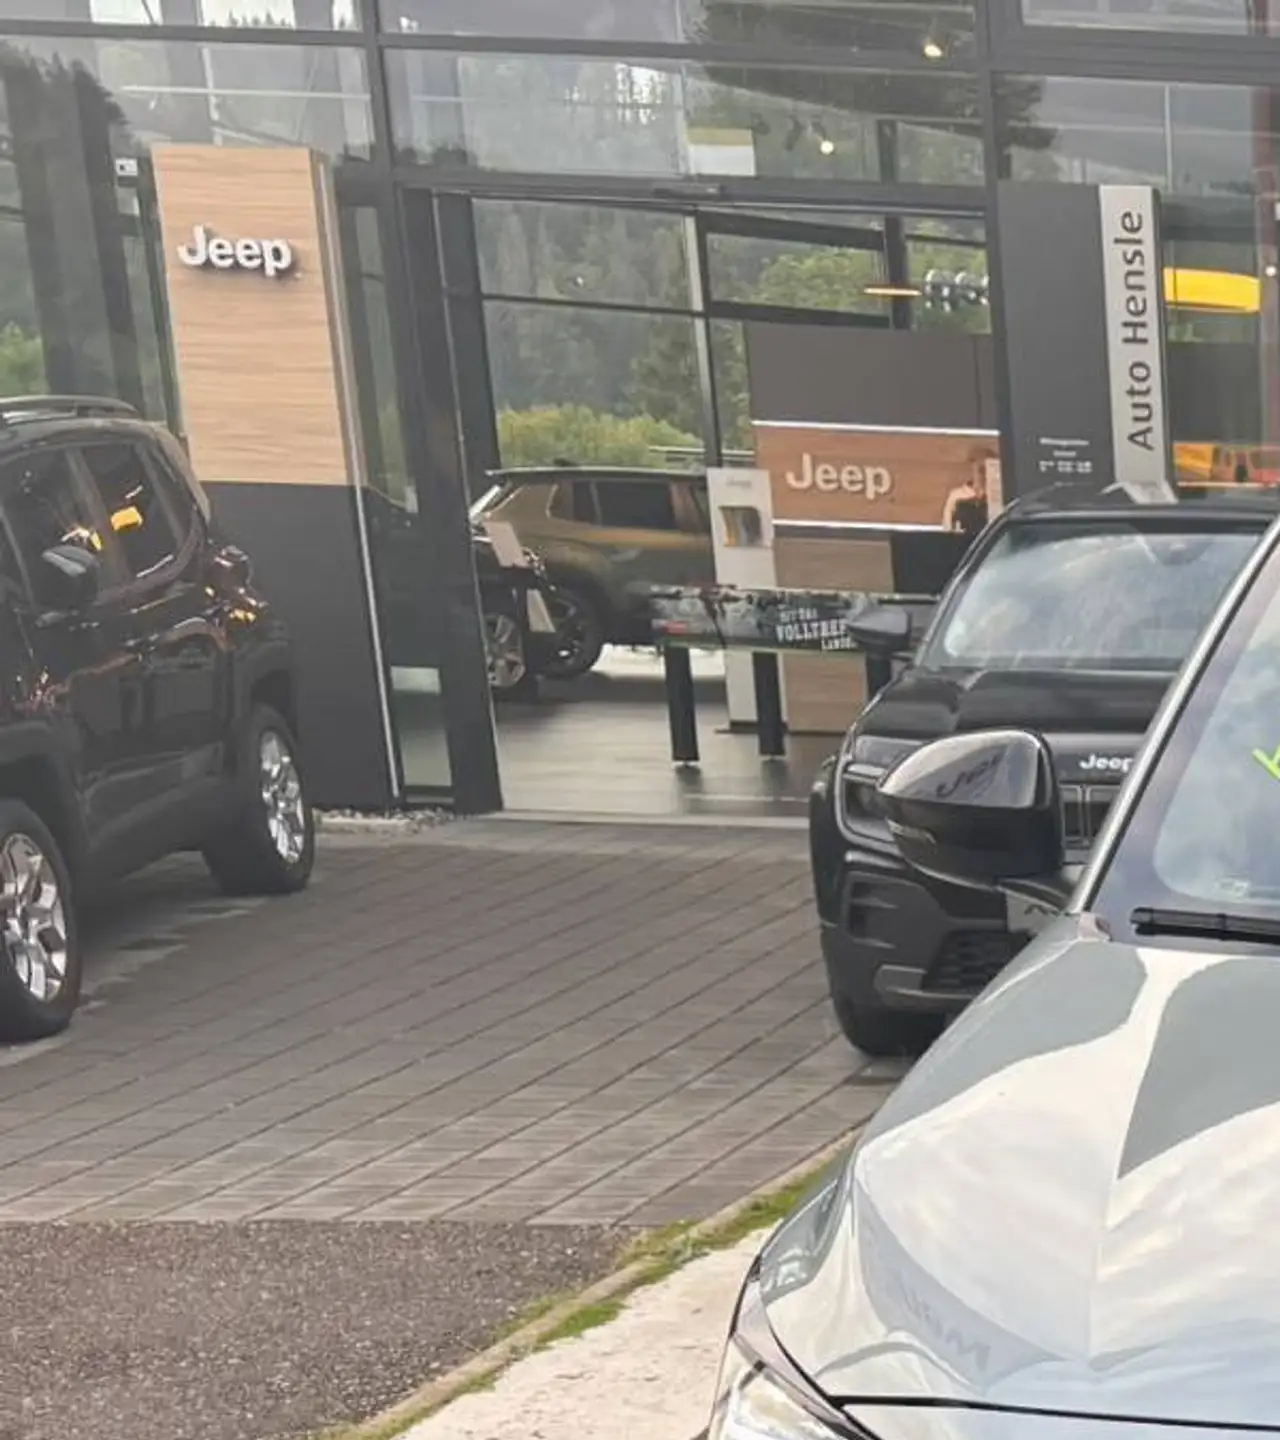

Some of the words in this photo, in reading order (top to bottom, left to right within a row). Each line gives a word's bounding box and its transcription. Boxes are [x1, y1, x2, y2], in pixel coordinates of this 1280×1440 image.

[177, 224, 292, 277] Jeep
[1113, 210, 1149, 345] Hensle
[1126, 360, 1154, 452] Auto
[785, 452, 893, 500] Jeep
